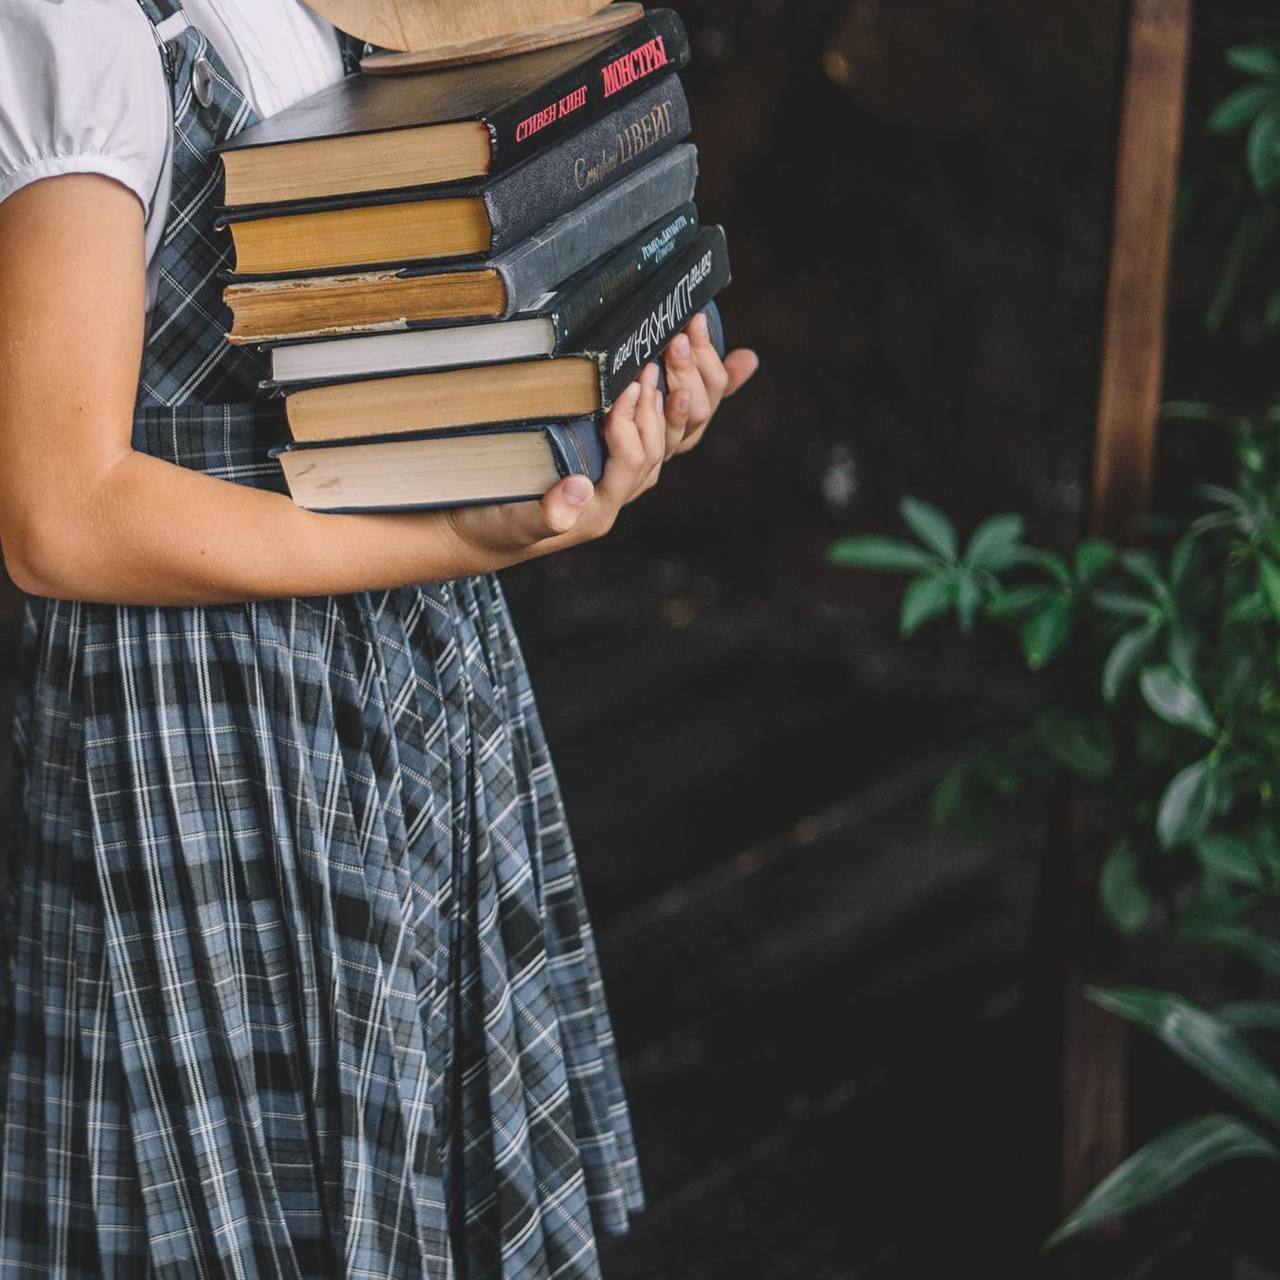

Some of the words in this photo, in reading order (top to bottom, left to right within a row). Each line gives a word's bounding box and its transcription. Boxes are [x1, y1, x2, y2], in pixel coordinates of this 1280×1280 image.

[515, 103, 557, 143] СТИВЕН
[558, 85, 588, 118] КИНГ
[601, 35, 668, 98] МОНСТРЫ
[617, 101, 673, 164] ЦВЕЙГ
